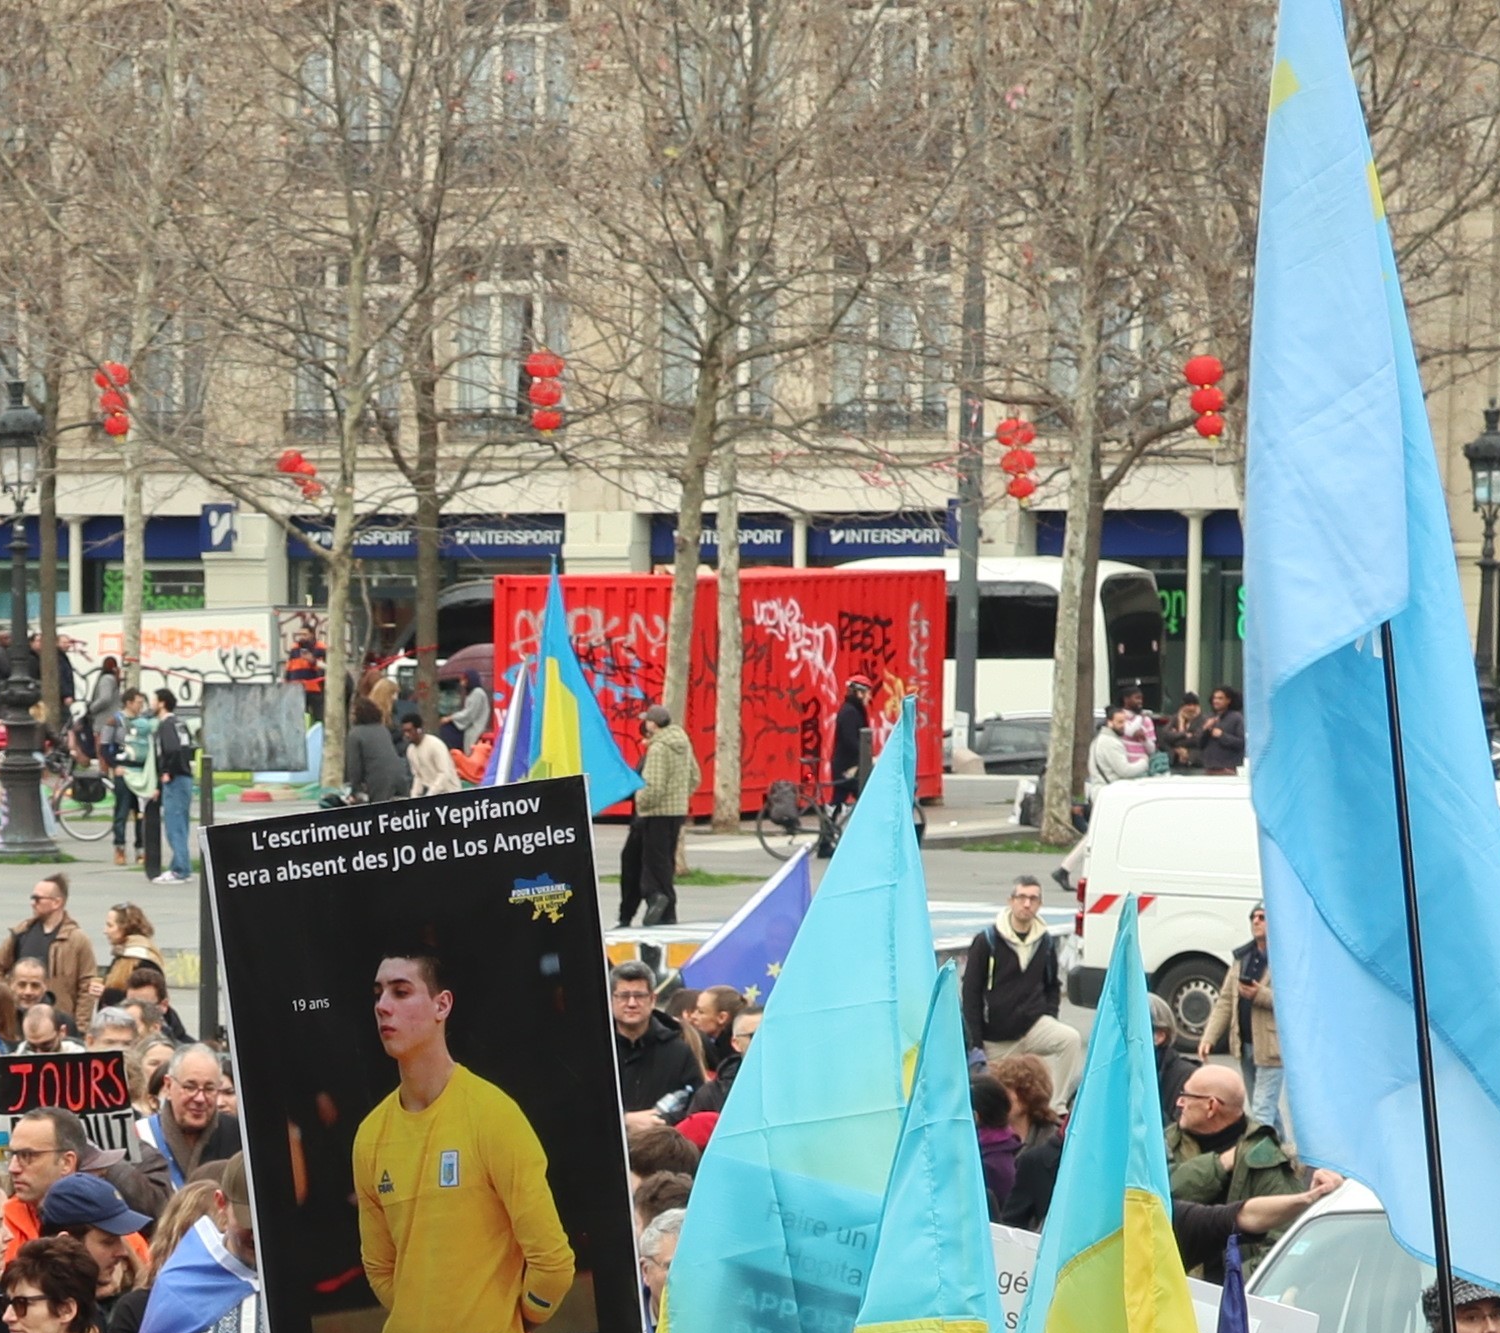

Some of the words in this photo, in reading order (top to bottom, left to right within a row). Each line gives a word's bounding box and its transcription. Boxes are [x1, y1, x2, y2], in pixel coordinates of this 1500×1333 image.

[471, 529, 562, 546] INTERSPORT
[845, 528, 942, 545] INTERSPORT
[378, 808, 431, 835] Fedir
[434, 797, 542, 830] Yepifanov
[227, 868, 271, 889] sera
[276, 853, 347, 882] absent
[352, 850, 389, 874] des
[391, 845, 417, 872] JO
[421, 840, 448, 862] de
[452, 836, 488, 858] Los
[493, 825, 576, 855] Angeles
[291, 999, 306, 1013] 19
[308, 996, 331, 1012] ans
[7, 1057, 127, 1112] JOURS
[837, 1224, 868, 1250] un
